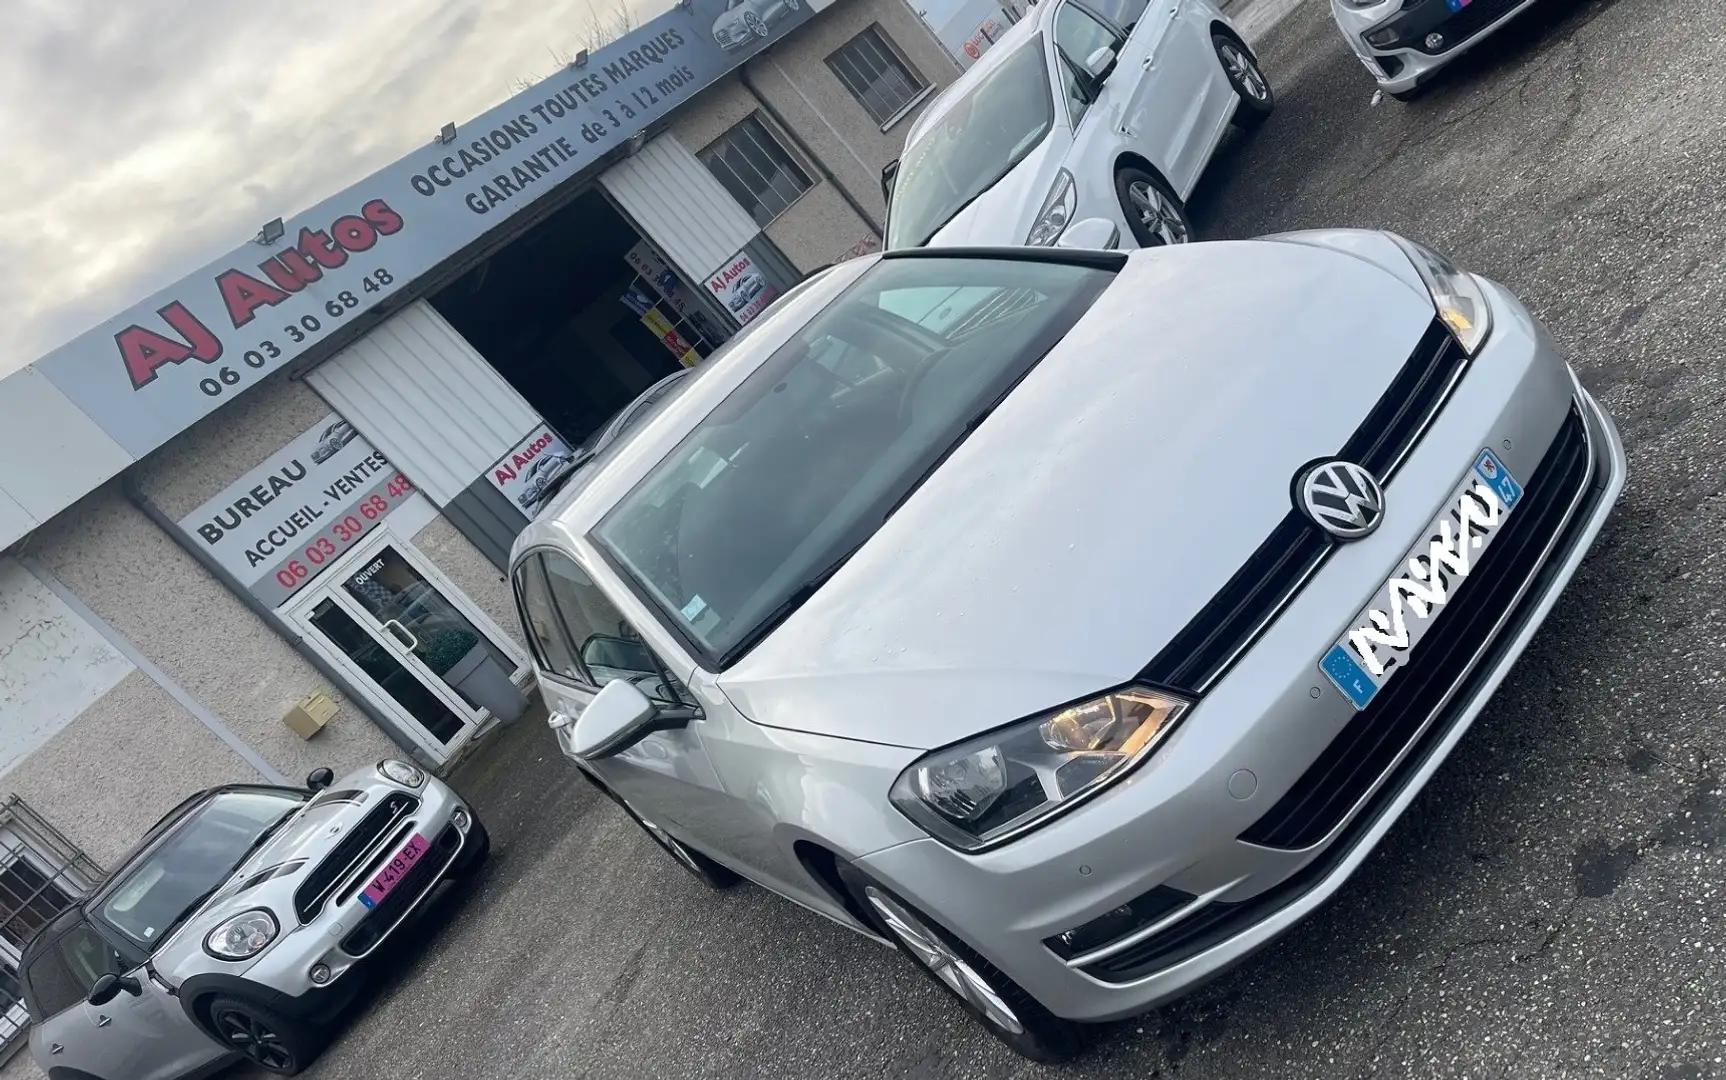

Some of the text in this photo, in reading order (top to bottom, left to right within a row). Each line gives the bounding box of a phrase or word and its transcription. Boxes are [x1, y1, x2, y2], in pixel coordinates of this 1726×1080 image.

[410, 28, 685, 197] OCCASIONS TOUTES MARQUES
[465, 65, 695, 215] GARANTIE de 3 à 12 mois
[114, 199, 404, 391] AJ Autos
[711, 258, 751, 293] AJ Autos
[200, 268, 394, 396] 06 03 30 68 48
[197, 459, 307, 545] BUREAU
[244, 505, 324, 568] ACCUEIL
[323, 450, 388, 501] VENTES
[494, 432, 553, 486] AJ Autos
[1498, 476, 1517, 504] 47
[276, 472, 414, 588] 06 03 30 68 48
[355, 558, 385, 585] OUVERT
[1353, 680, 1364, 694] F
